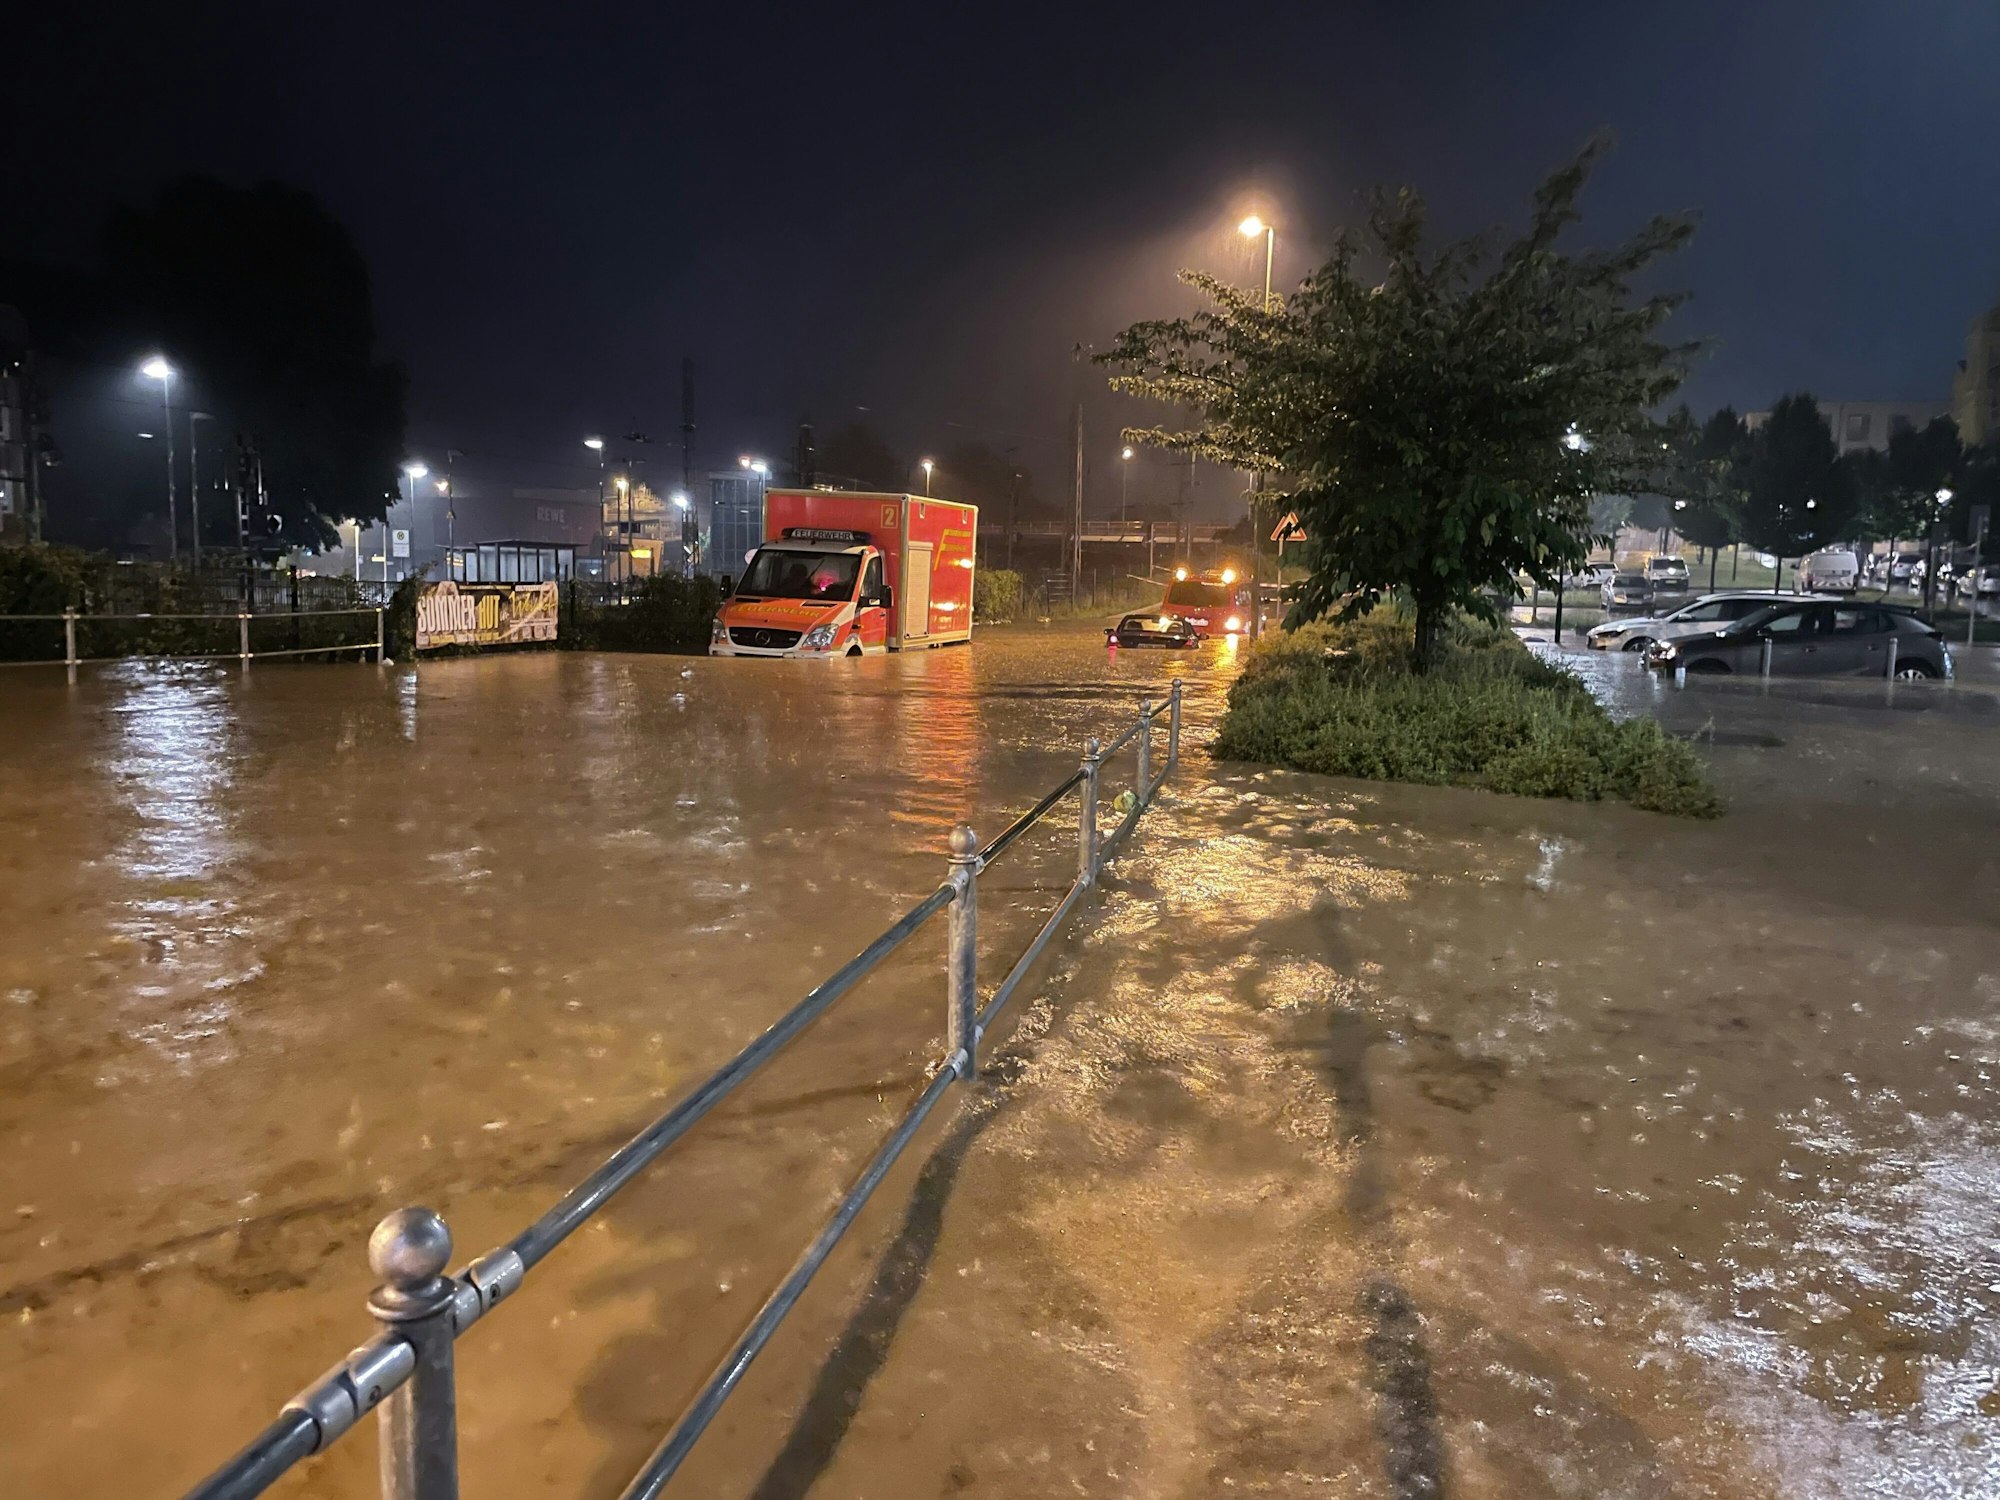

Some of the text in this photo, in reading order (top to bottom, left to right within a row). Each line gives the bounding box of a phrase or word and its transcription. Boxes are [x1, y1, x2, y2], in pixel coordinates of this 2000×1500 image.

[537, 506, 566, 524] REWE
[884, 508, 895, 526] 2
[794, 529, 852, 541] FEUERWEHR
[417, 595, 476, 633] SOMMER
[728, 604, 821, 618] FEUERWEHR
